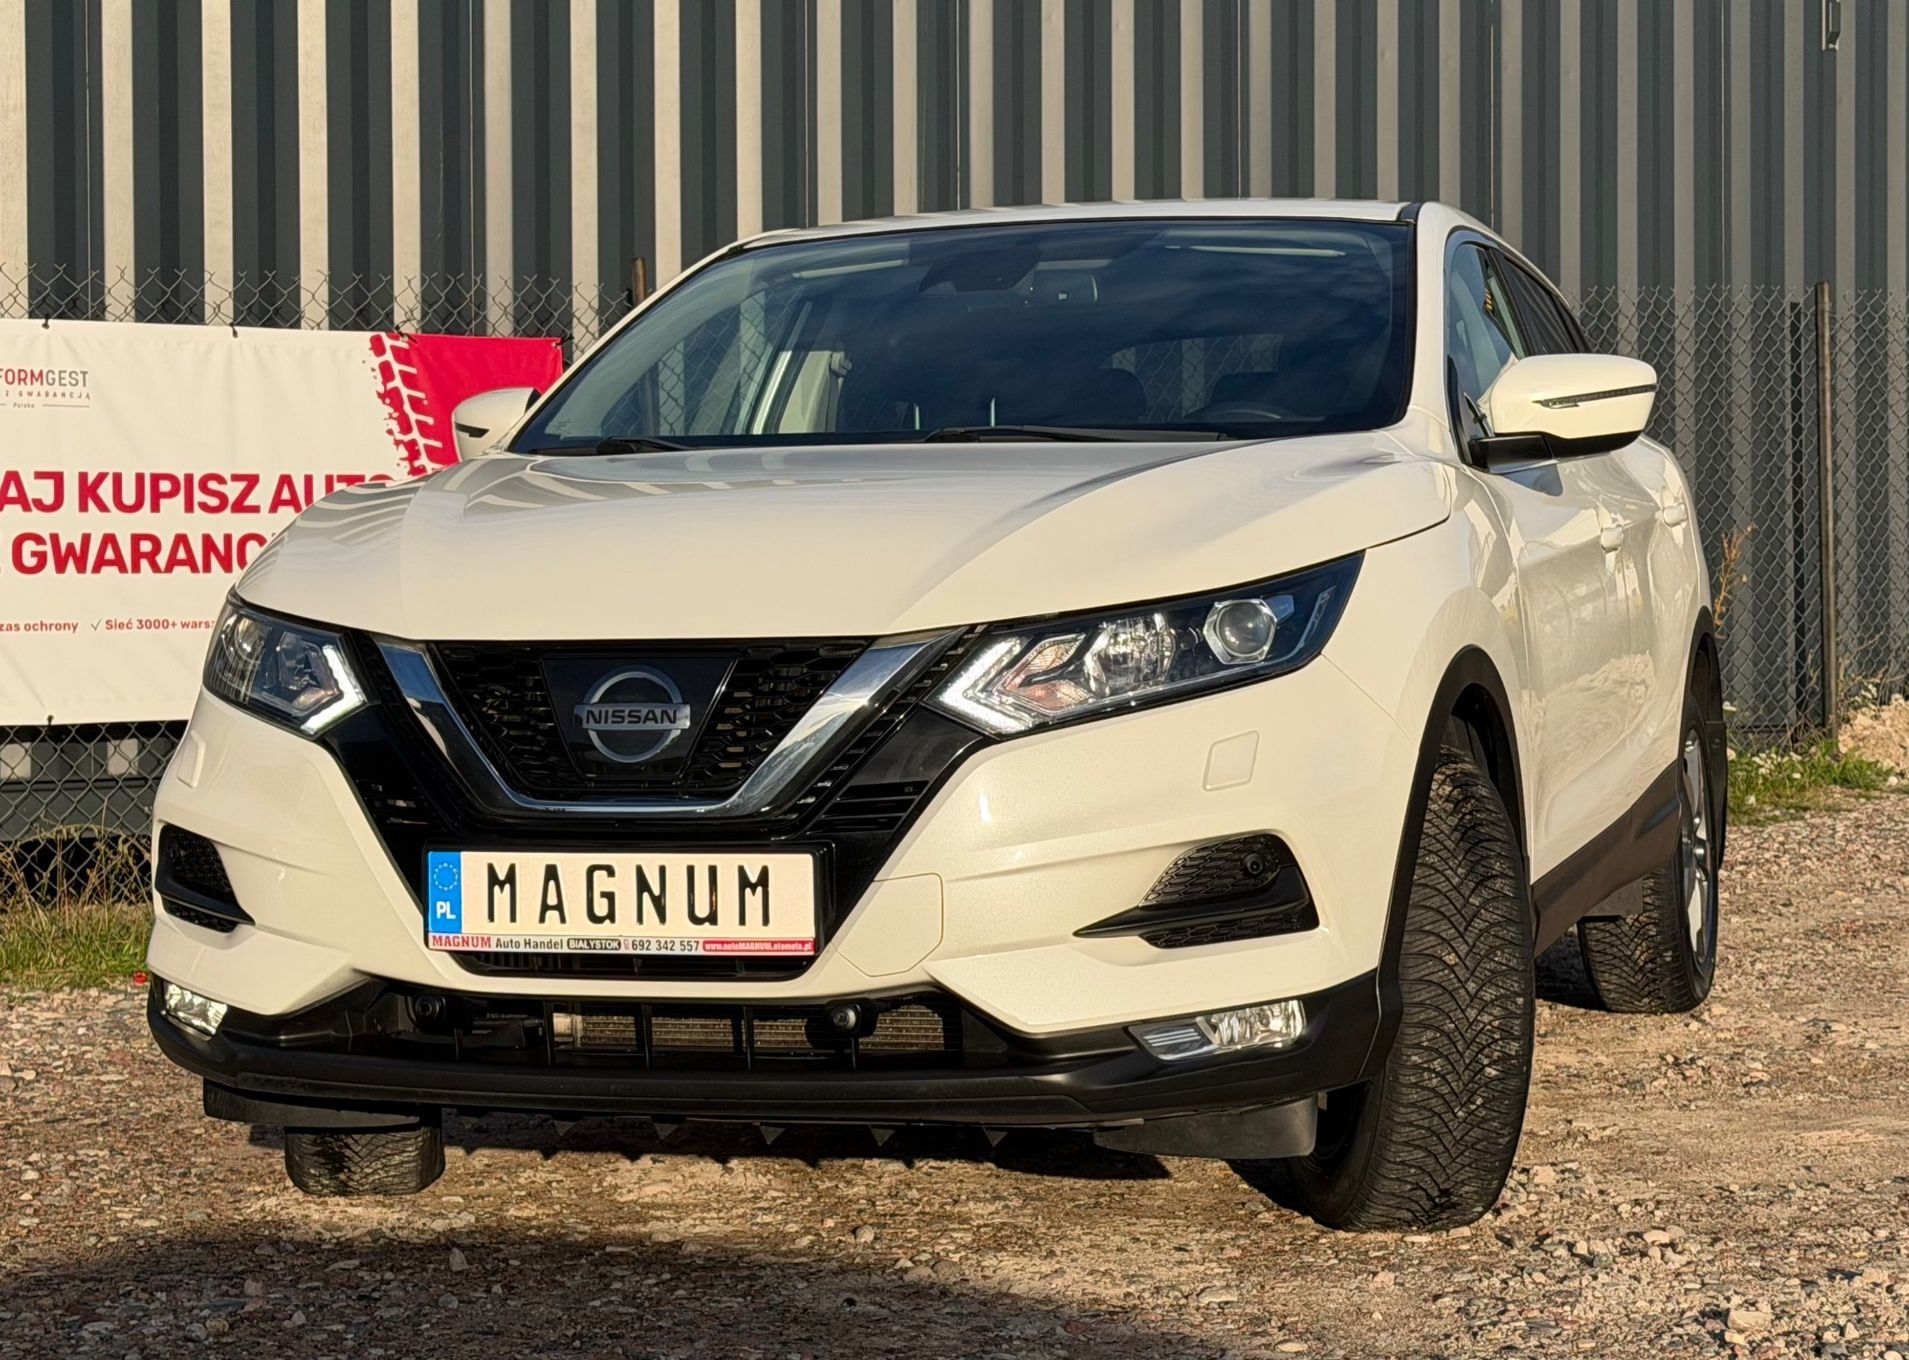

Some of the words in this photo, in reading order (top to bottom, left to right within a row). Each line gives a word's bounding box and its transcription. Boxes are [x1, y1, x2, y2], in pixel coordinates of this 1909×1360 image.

[78, 472, 261, 513] KUPISZ
[24, 620, 78, 633] ochrony
[105, 619, 133, 630] Sieć
[136, 619, 177, 630] 3000+
[585, 709, 677, 724] NISSAN
[486, 862, 770, 927] MAGNUM
[436, 901, 456, 920] PL
[432, 935, 491, 948] MAGNUM
[495, 938, 520, 949] Auto
[524, 938, 563, 950] Handel
[631, 940, 651, 951] 692
[655, 940, 675, 951] 342
[680, 940, 699, 952] 557
